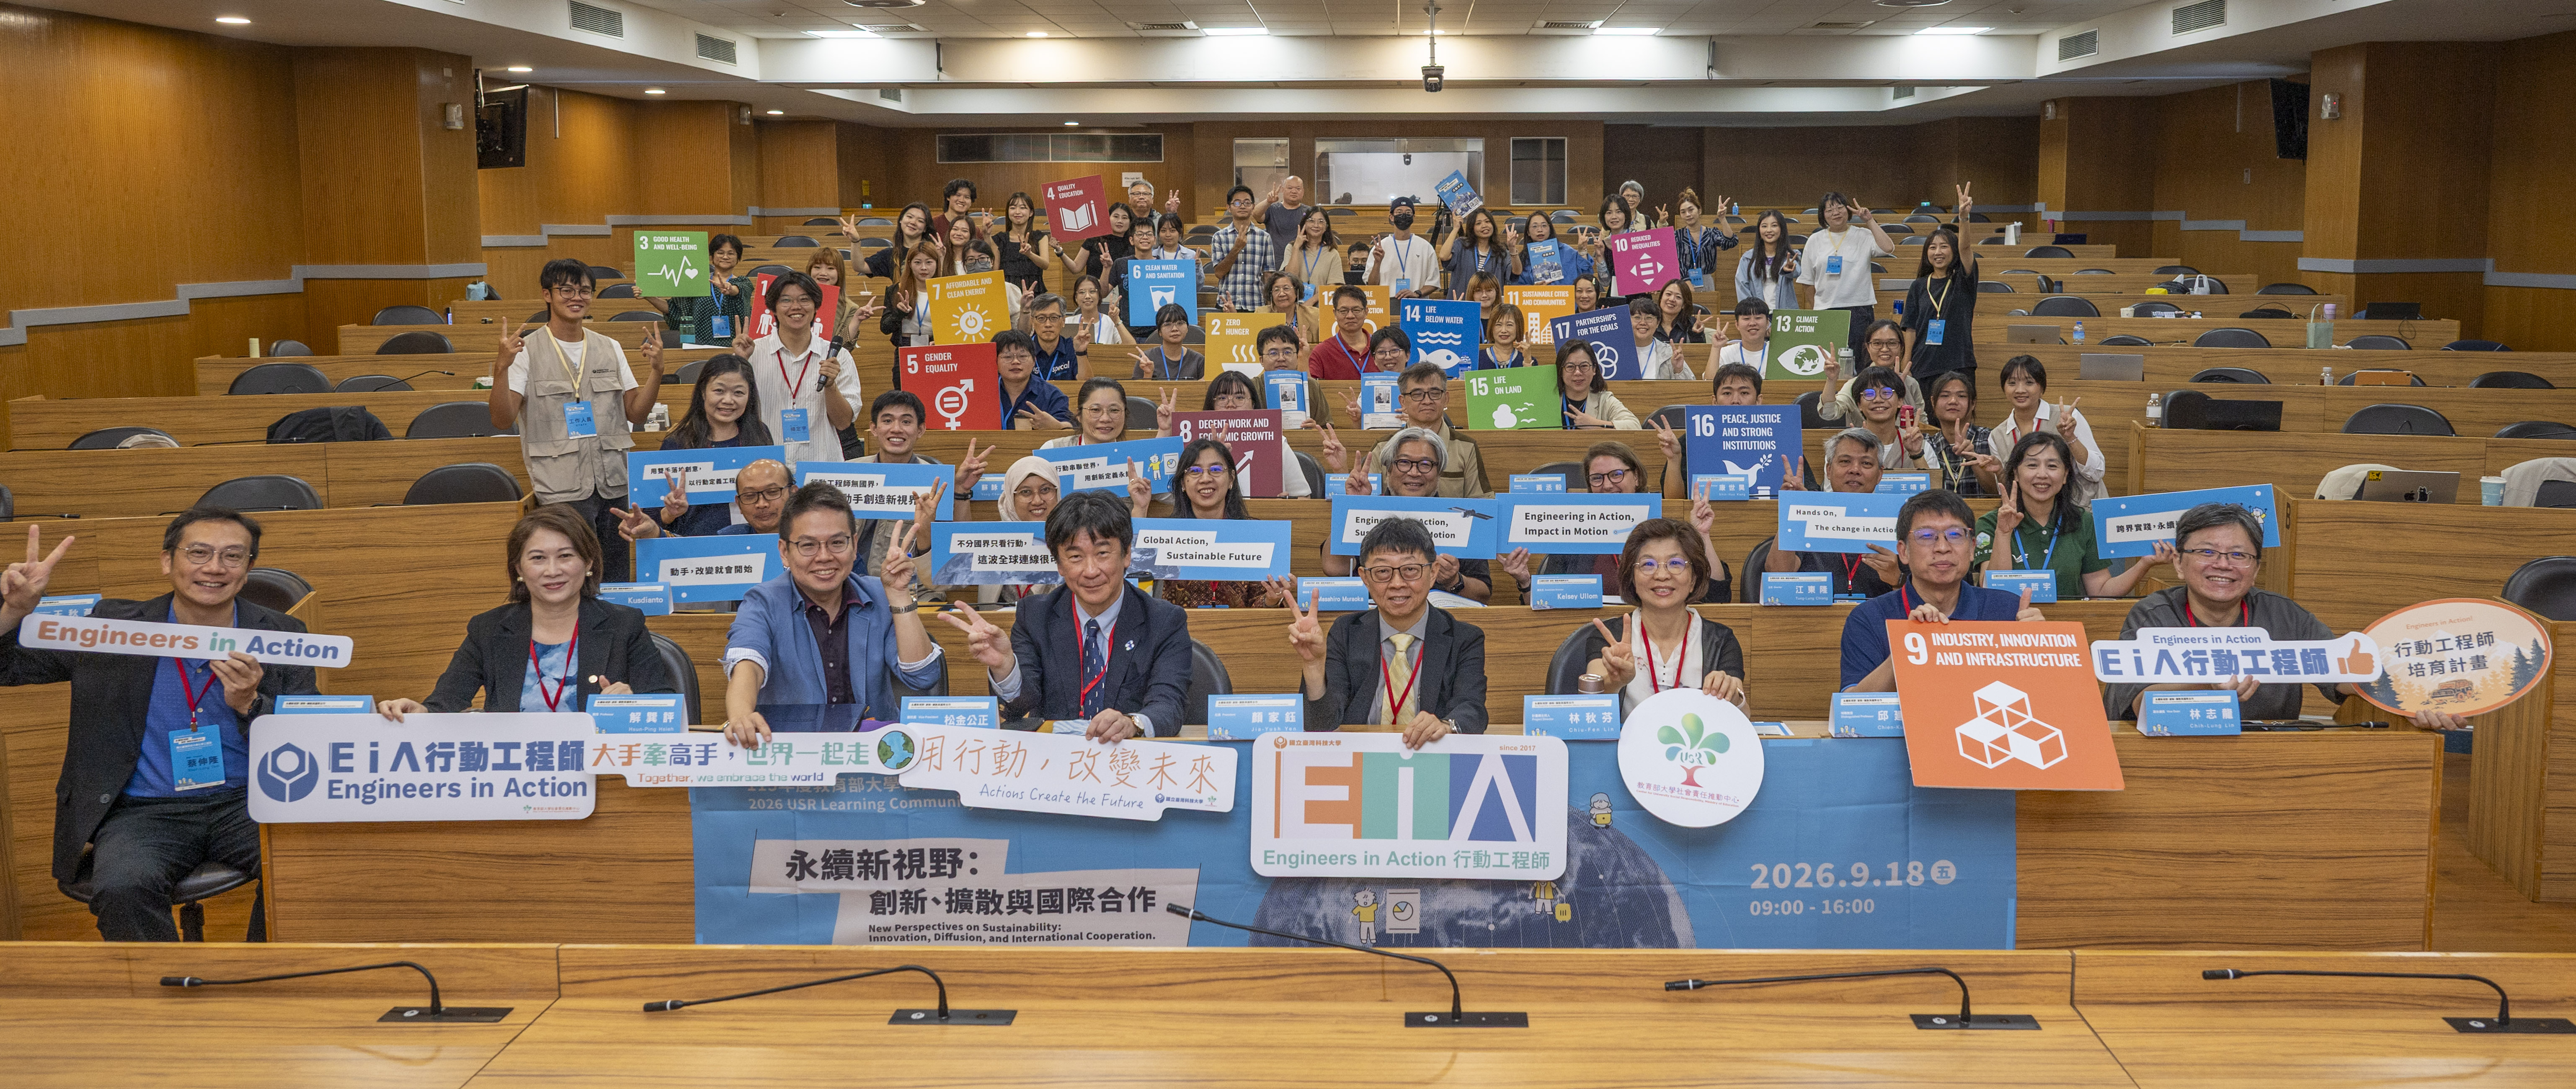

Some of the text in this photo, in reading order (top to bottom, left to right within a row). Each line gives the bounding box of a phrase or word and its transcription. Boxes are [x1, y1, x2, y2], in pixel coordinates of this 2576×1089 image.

[1047, 184, 1076, 200] 4 QUALITY
[1058, 189, 1083, 198] EDUCATION
[640, 236, 648, 250] 3
[1614, 238, 1628, 252] 10
[1632, 241, 1660, 250] INEQUALITIES
[1133, 265, 1141, 279] 6
[761, 280, 768, 296] 1
[933, 284, 940, 300] 7
[946, 279, 980, 289] AFFORDABLE
[964, 288, 986, 297] ENERGY
[1508, 292, 1519, 305] 11
[1404, 306, 1420, 322] 14
[1211, 319, 1220, 335] 2
[1556, 314, 1616, 339] 17 PARTNERSHIPS
[1601, 323, 1618, 332] GOALS
[1776, 316, 1790, 331] 13
[907, 352, 952, 374] 5 GENDER
[925, 363, 958, 373] EQUALITY
[1470, 377, 1488, 396] 15
[1180, 419, 1269, 443] 8 WORK AND
[1692, 414, 1781, 436] 16 PEACE, JUSTICE
[1722, 427, 1772, 436] AND STRONG
[1241, 431, 1274, 441] GROWTH
[1722, 440, 1776, 450] INSTITUTIONS
[1525, 512, 1584, 523] Engineering
[1599, 513, 1634, 523] Action,
[1525, 527, 1559, 537] Impact
[1834, 525, 1861, 535] change
[1864, 525, 1870, 534] in
[958, 539, 1027, 548] 不分國界只看行動，
[1143, 536, 1208, 546] Global Action,
[1167, 551, 1225, 561] Sustainable
[670, 565, 752, 577] 動手，改變就會開始
[1796, 585, 1827, 594] 江東隆
[2406, 621, 2438, 630] Engineers
[38, 621, 338, 659] Engineers in Action
[2153, 635, 2261, 646] Engineers in Action
[2395, 631, 2495, 657] 行動工程師
[1904, 632, 2077, 665] 9 INDUSTRY, INNOVATION
[1936, 652, 2082, 667] AND INFRASTRUCTURE
[2408, 654, 2488, 678] 培育計畫
[945, 715, 989, 726] 松金公正
[1252, 712, 1296, 723] 顏家鈺
[1569, 712, 1612, 723] 林秋芬
[2190, 708, 2233, 719] 林志龍
[592, 742, 870, 767] 大手牽高手，世界一起走
[1680, 751, 1703, 765] USR
[638, 773, 693, 784] Together,
[717, 773, 766, 782] embrace
[770, 773, 787, 781] the
[790, 772, 823, 781] world
[328, 777, 586, 804] Engineers in Action
[980, 783, 1143, 808] Actions Create the Future
[1637, 782, 1739, 803] 教育部大學社會責任推動中心
[749, 797, 897, 813] 2026 USR Learning
[786, 847, 978, 880] 永續新視野：
[1263, 850, 1550, 870] Engineers in Action 行動工程師
[1750, 861, 1924, 890] 2026.9.18
[1936, 865, 1951, 879] 五
[869, 887, 1156, 915] 創新、擴散與國際合作
[1750, 899, 1874, 915] 09:00 16:00
[895, 923, 964, 933] Perspectives
[982, 922, 1061, 932] Sustainability:
[869, 934, 929, 942] Innovation,
[934, 933, 986, 942] Diffusion,
[1012, 932, 1083, 940] International
[1087, 932, 1156, 941] Cooperation.
